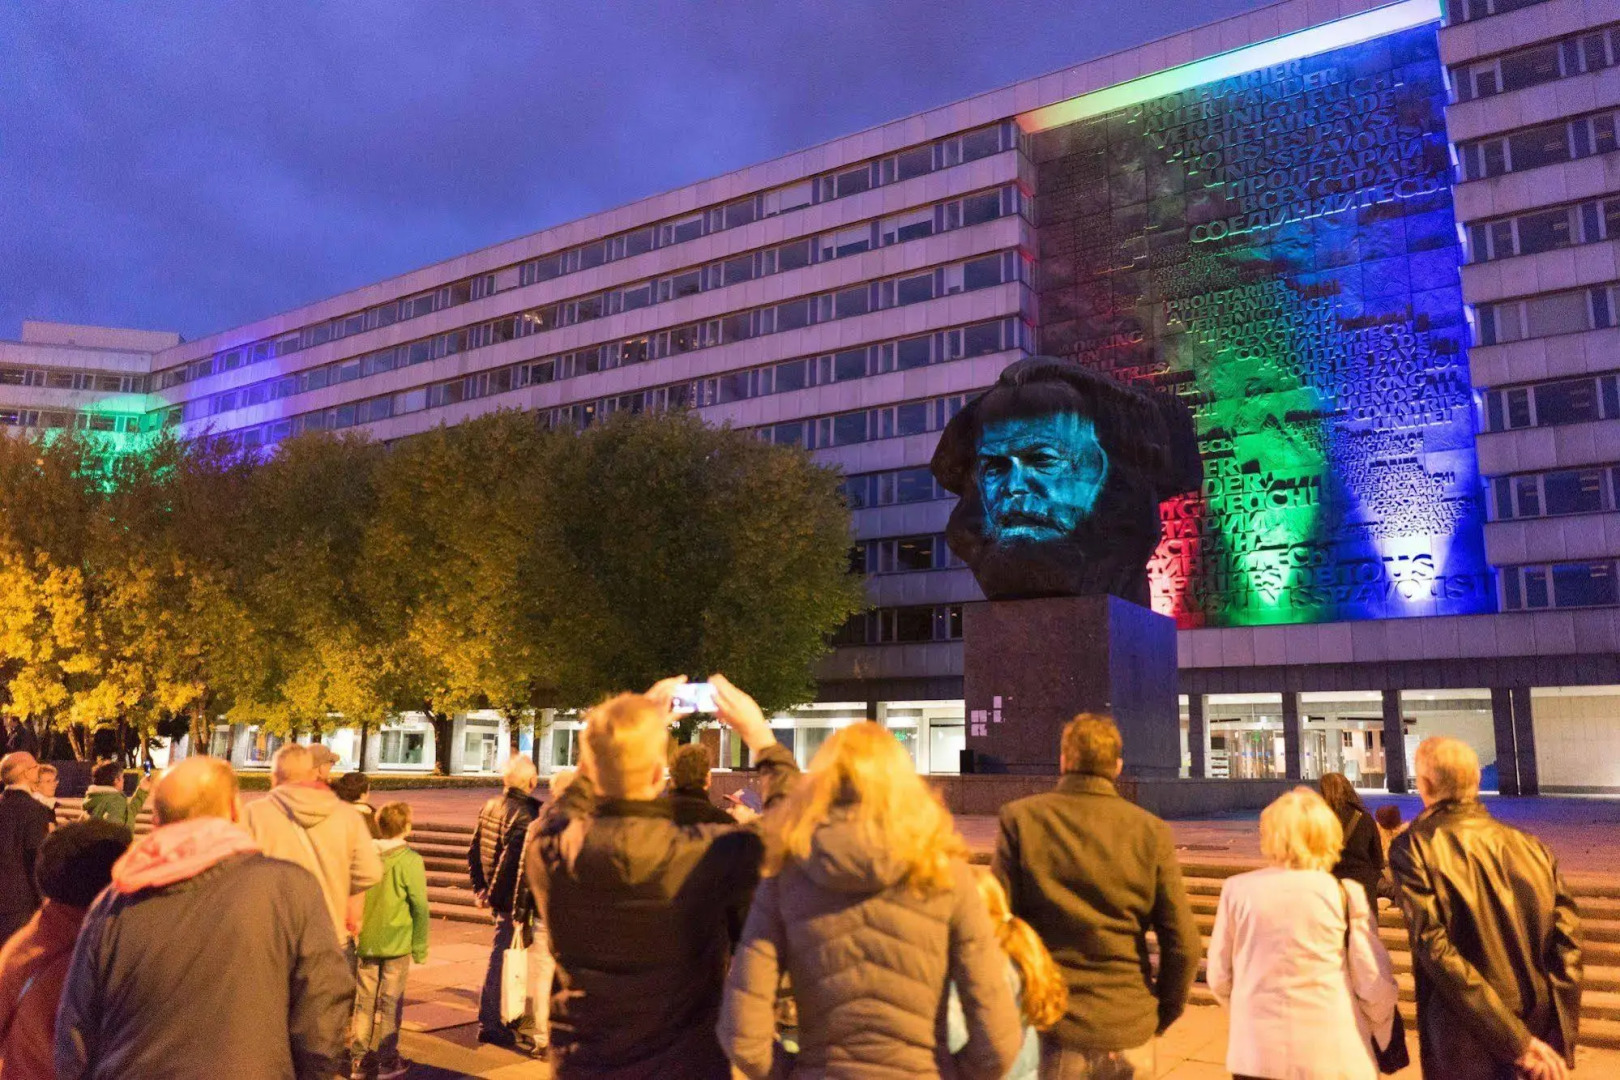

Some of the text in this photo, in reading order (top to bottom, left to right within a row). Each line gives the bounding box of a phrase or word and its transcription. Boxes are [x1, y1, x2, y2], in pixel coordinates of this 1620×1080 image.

[1355, 88, 1396, 116] DE
[1186, 142, 1262, 174] TOUS
[1265, 130, 1308, 159] LES
[1166, 279, 1287, 313] PROLETARIER
[1166, 305, 1219, 325] ALLER
[1180, 307, 1281, 334] VEREINIGT
[1258, 331, 1430, 371] PROLETAIRES DE
[1278, 361, 1332, 380] TOUS
[1335, 354, 1368, 370] LES
[1312, 372, 1427, 400] WORKING
[1335, 381, 1458, 411] MEN OF ALL
[1372, 408, 1453, 432] UNITE!
[1342, 463, 1418, 482] PROLETARIER
[1226, 486, 1320, 515] EUCH!
